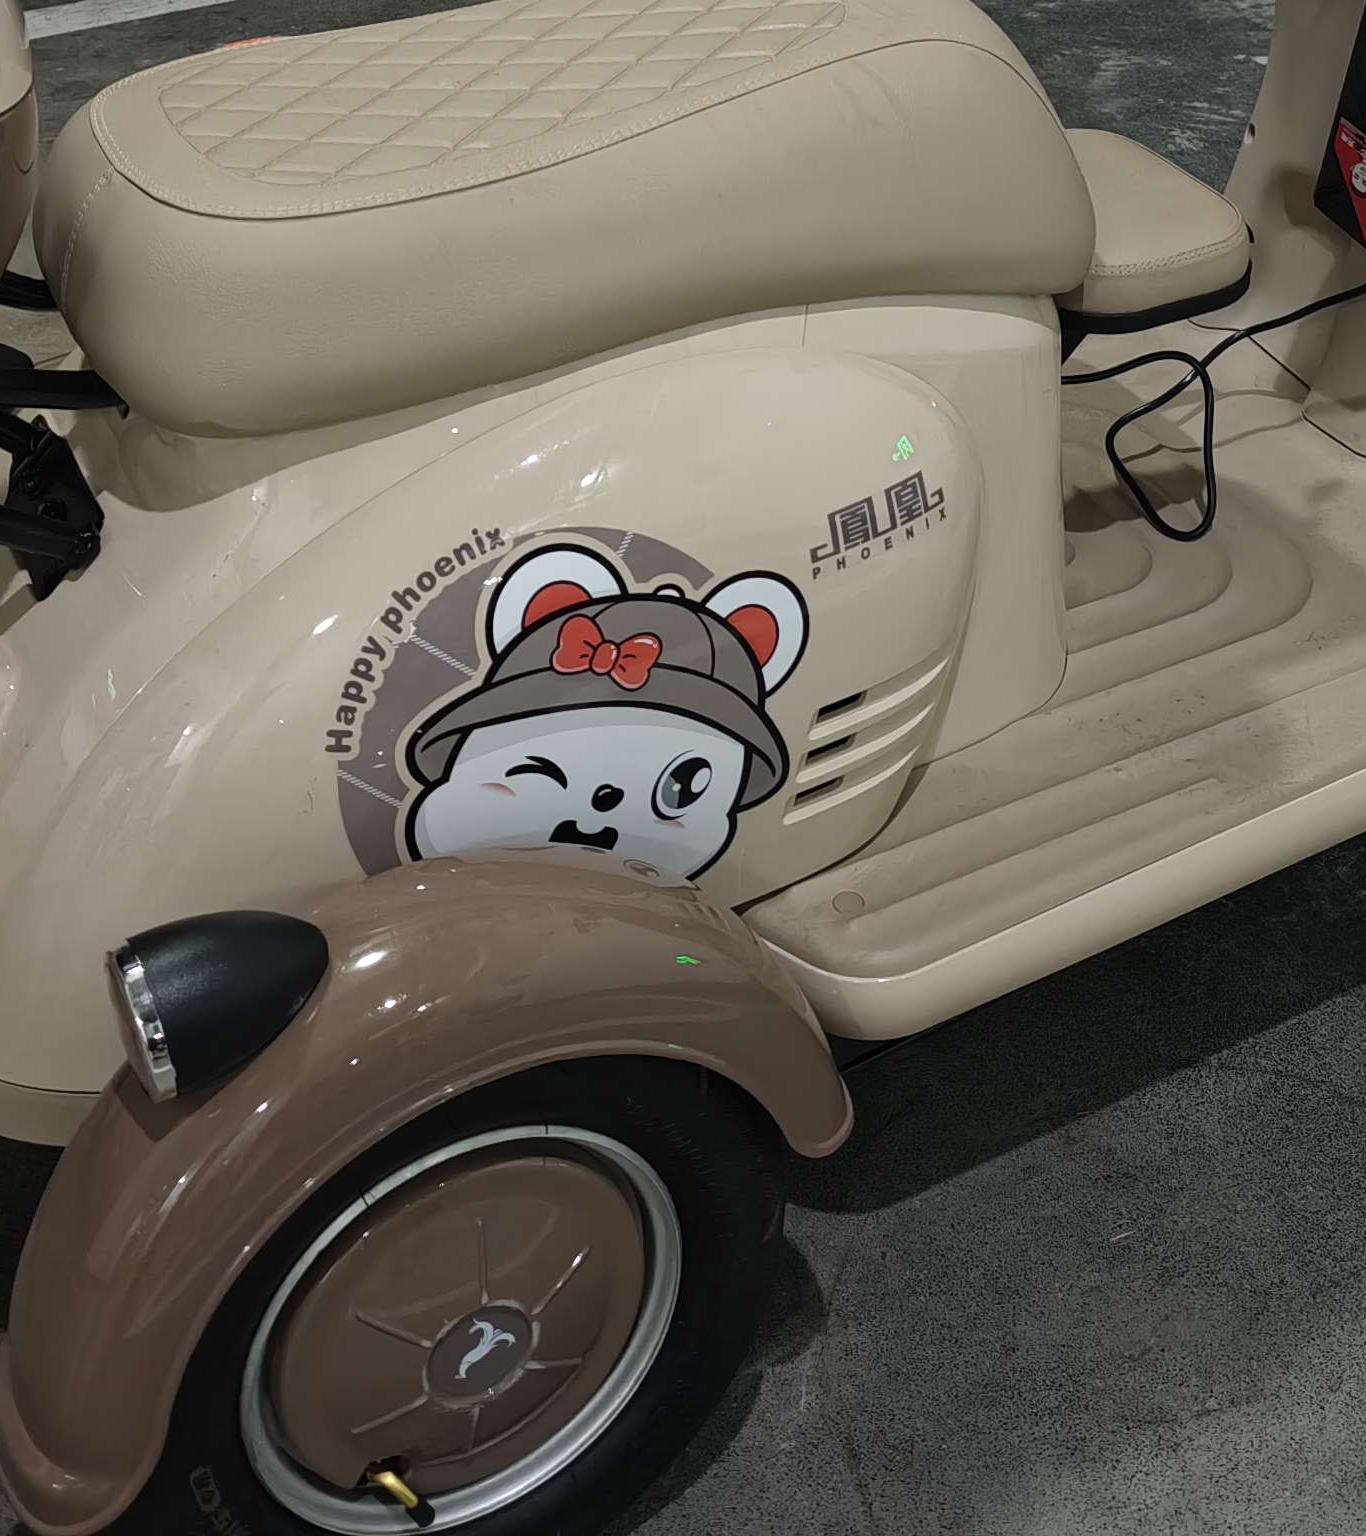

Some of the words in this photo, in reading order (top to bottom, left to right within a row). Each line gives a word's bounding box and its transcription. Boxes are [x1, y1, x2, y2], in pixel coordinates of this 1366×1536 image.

[812, 507, 947, 580] PHOENIX
[325, 635, 386, 753] Happy
[380, 527, 506, 635] phoenix
